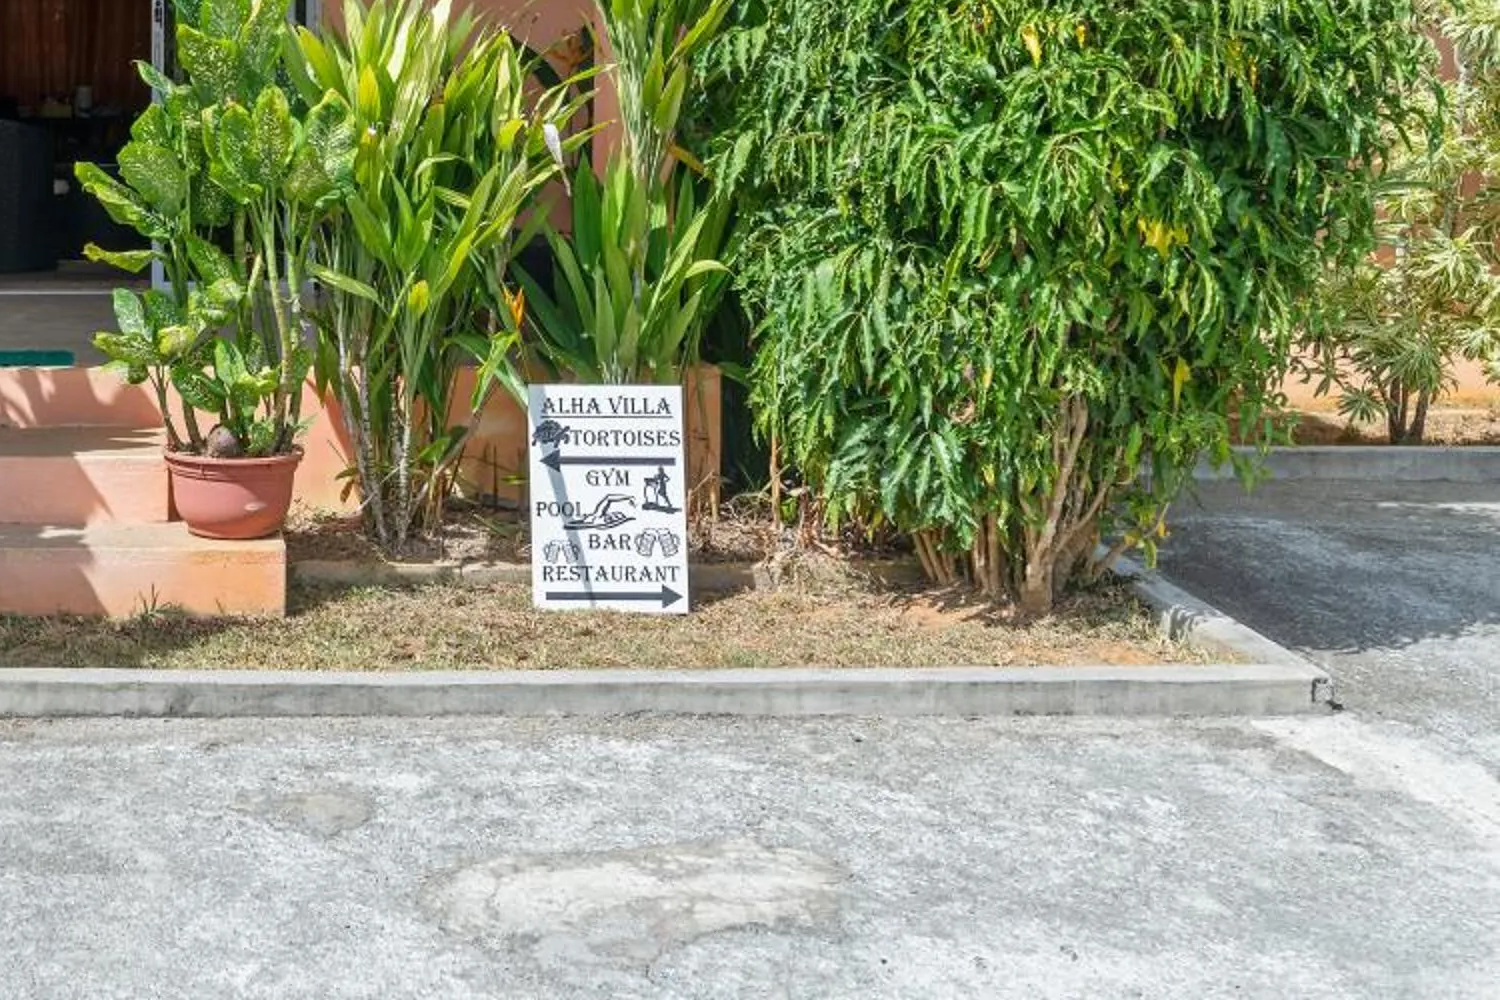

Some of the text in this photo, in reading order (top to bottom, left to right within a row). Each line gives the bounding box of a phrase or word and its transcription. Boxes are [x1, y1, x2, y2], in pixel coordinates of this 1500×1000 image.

[541, 395, 672, 415] ALHA VILLA
[570, 429, 681, 447] TORTOISES
[585, 468, 631, 487] GYM
[535, 501, 583, 517] POOL
[588, 533, 631, 551] BAR
[542, 565, 681, 583] RESTAURANT
